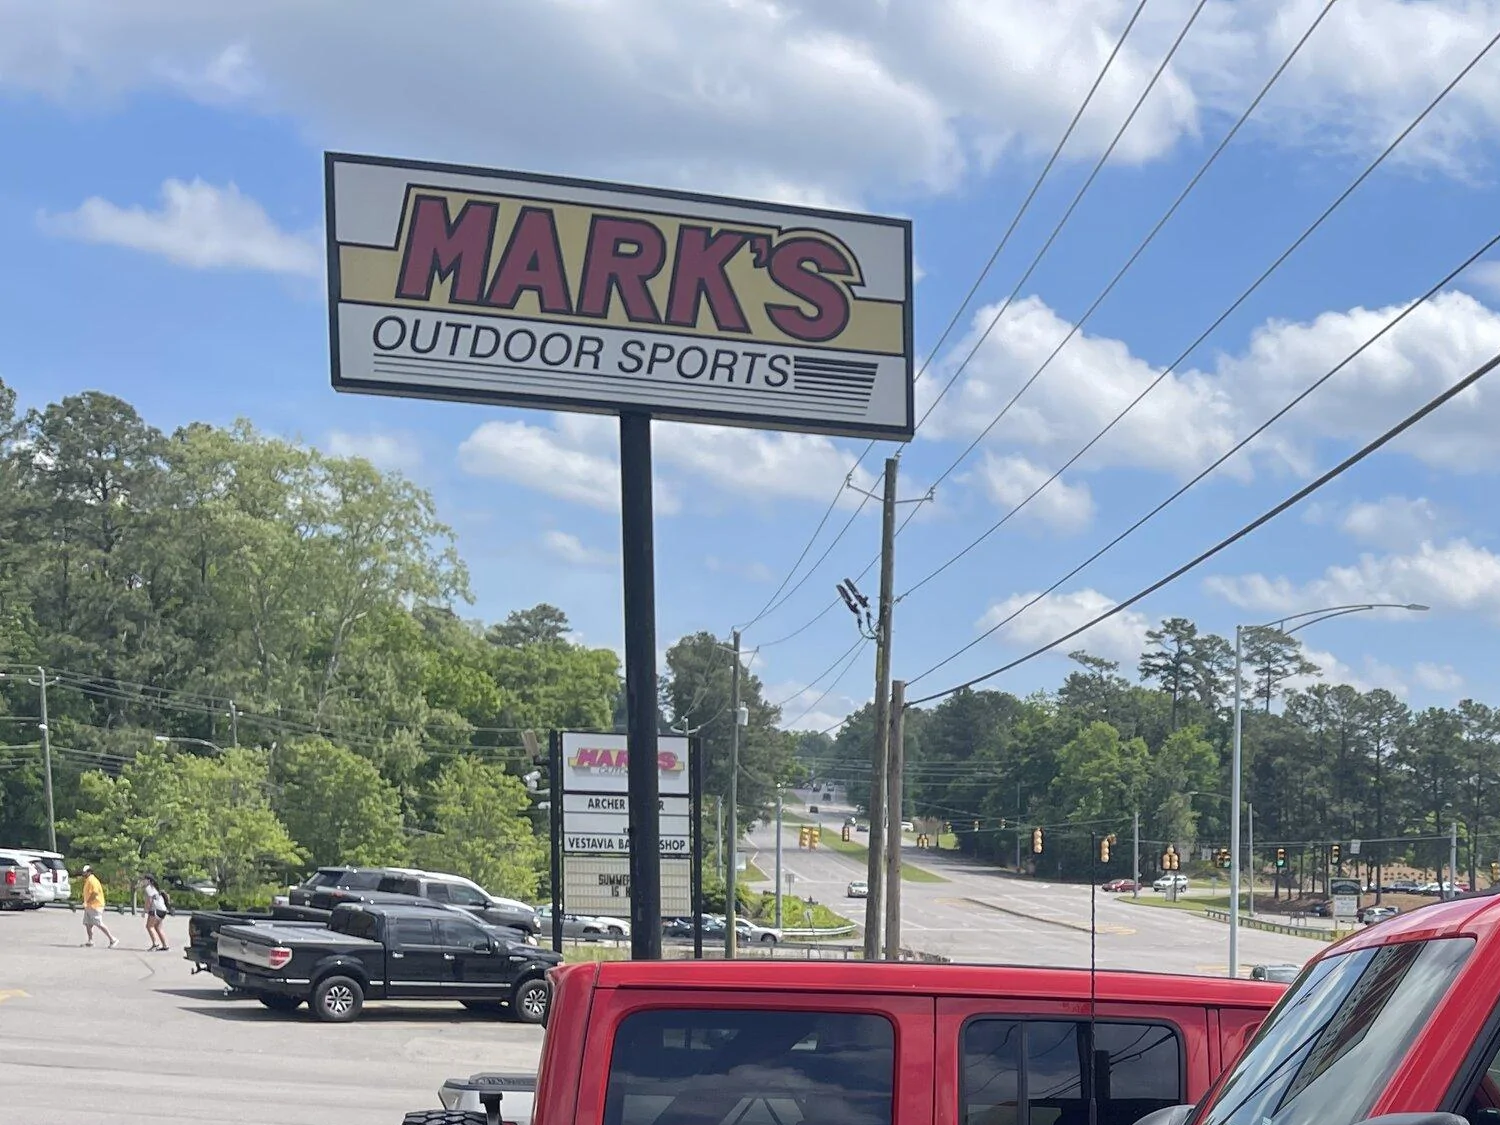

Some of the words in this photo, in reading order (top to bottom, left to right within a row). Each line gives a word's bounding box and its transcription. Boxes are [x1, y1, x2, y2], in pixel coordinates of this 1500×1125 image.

[395, 193, 850, 342] MARK'S
[372, 315, 604, 368] OUTDOOR
[617, 339, 791, 388] SPORTS
[577, 748, 678, 770] MARS
[587, 798, 626, 810] ARCHER
[568, 837, 614, 850] VESTAVIA
[660, 839, 686, 851] SHOP
